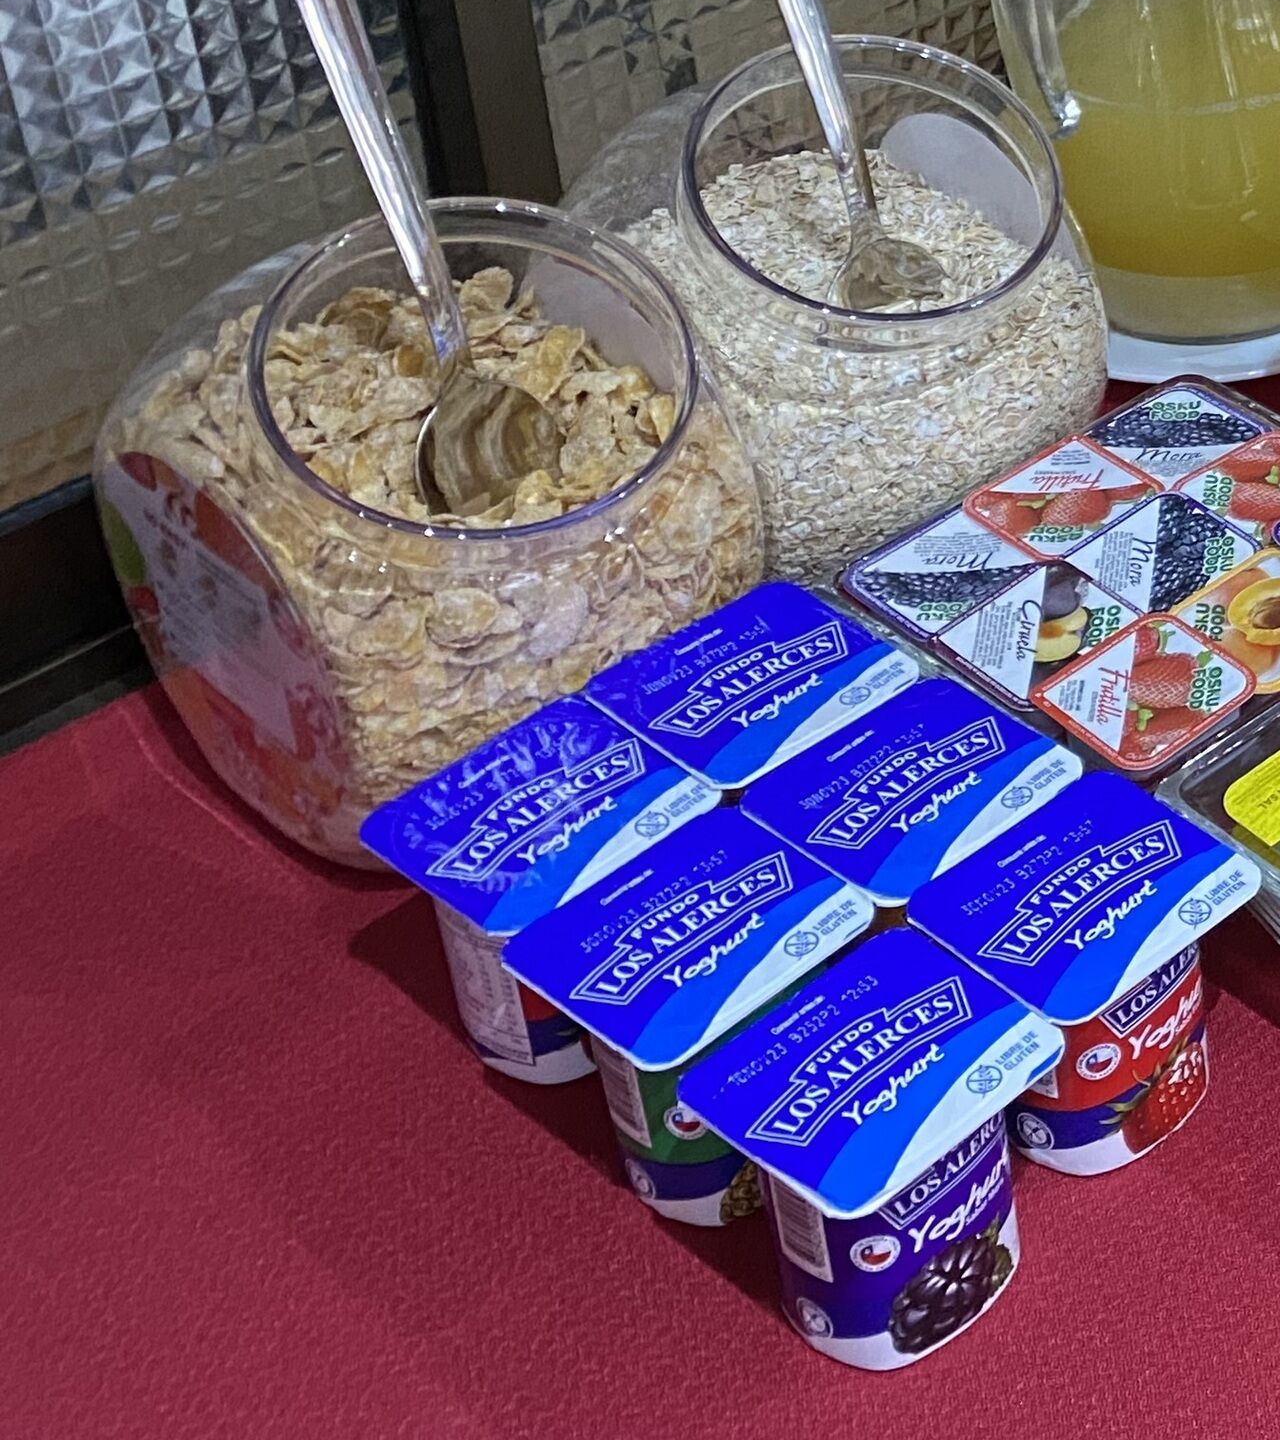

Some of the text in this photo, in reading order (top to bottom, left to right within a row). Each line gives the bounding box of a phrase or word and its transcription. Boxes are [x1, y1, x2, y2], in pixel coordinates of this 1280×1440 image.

[1150, 410, 1200, 421] FOOD
[1135, 447, 1204, 462] Mora
[1029, 469, 1104, 492] Frutilla
[1216, 476, 1233, 509] FOOD
[921, 552, 993, 570] Mora
[1129, 537, 1157, 586] Mora
[1204, 537, 1220, 574] FOOD
[1014, 599, 1044, 662] Ciruela
[672, 694, 723, 729] LOS
[720, 636, 834, 703] ALERCES
[703, 651, 763, 686] FUNDO
[1189, 668, 1206, 709] FOOD
[731, 672, 823, 728] Yoghurt
[1096, 666, 1131, 725] Frutilla
[829, 802, 882, 841] LOS
[878, 731, 990, 806] ALERCES
[858, 751, 918, 795] FUNDO
[451, 829, 509, 873] LOS
[507, 753, 630, 833] ALERCES
[486, 777, 555, 820] FUNDO
[890, 770, 983, 834] Yoghurt
[1257, 792, 1279, 809] SAL
[516, 796, 618, 865] Yoghurt
[1001, 910, 1055, 955] LOS
[1051, 834, 1166, 919] ALERCES
[1030, 856, 1092, 905] FUNDO
[1204, 869, 1244, 903] LIBRE DE
[1211, 880, 1248, 906] GLUTEN
[595, 949, 653, 994] LOS
[651, 868, 777, 953] ALERCES
[631, 893, 700, 939] FUNDO
[812, 898, 857, 932] LIBRE DE
[819, 909, 858, 936] GLUTEN
[1064, 879, 1158, 951] Yoghurt
[662, 913, 765, 988] Yoghurt
[1115, 986, 1158, 1024] LOS
[772, 1082, 830, 1135] LOS
[828, 993, 953, 1093] ALERCES
[805, 1019, 875, 1076] FUNDO
[994, 1029, 1038, 1066] LIBRE DE
[1002, 1041, 1041, 1071] GLUTEN
[841, 1043, 945, 1126] Yoghurt
[893, 1173, 943, 1216] LOS
